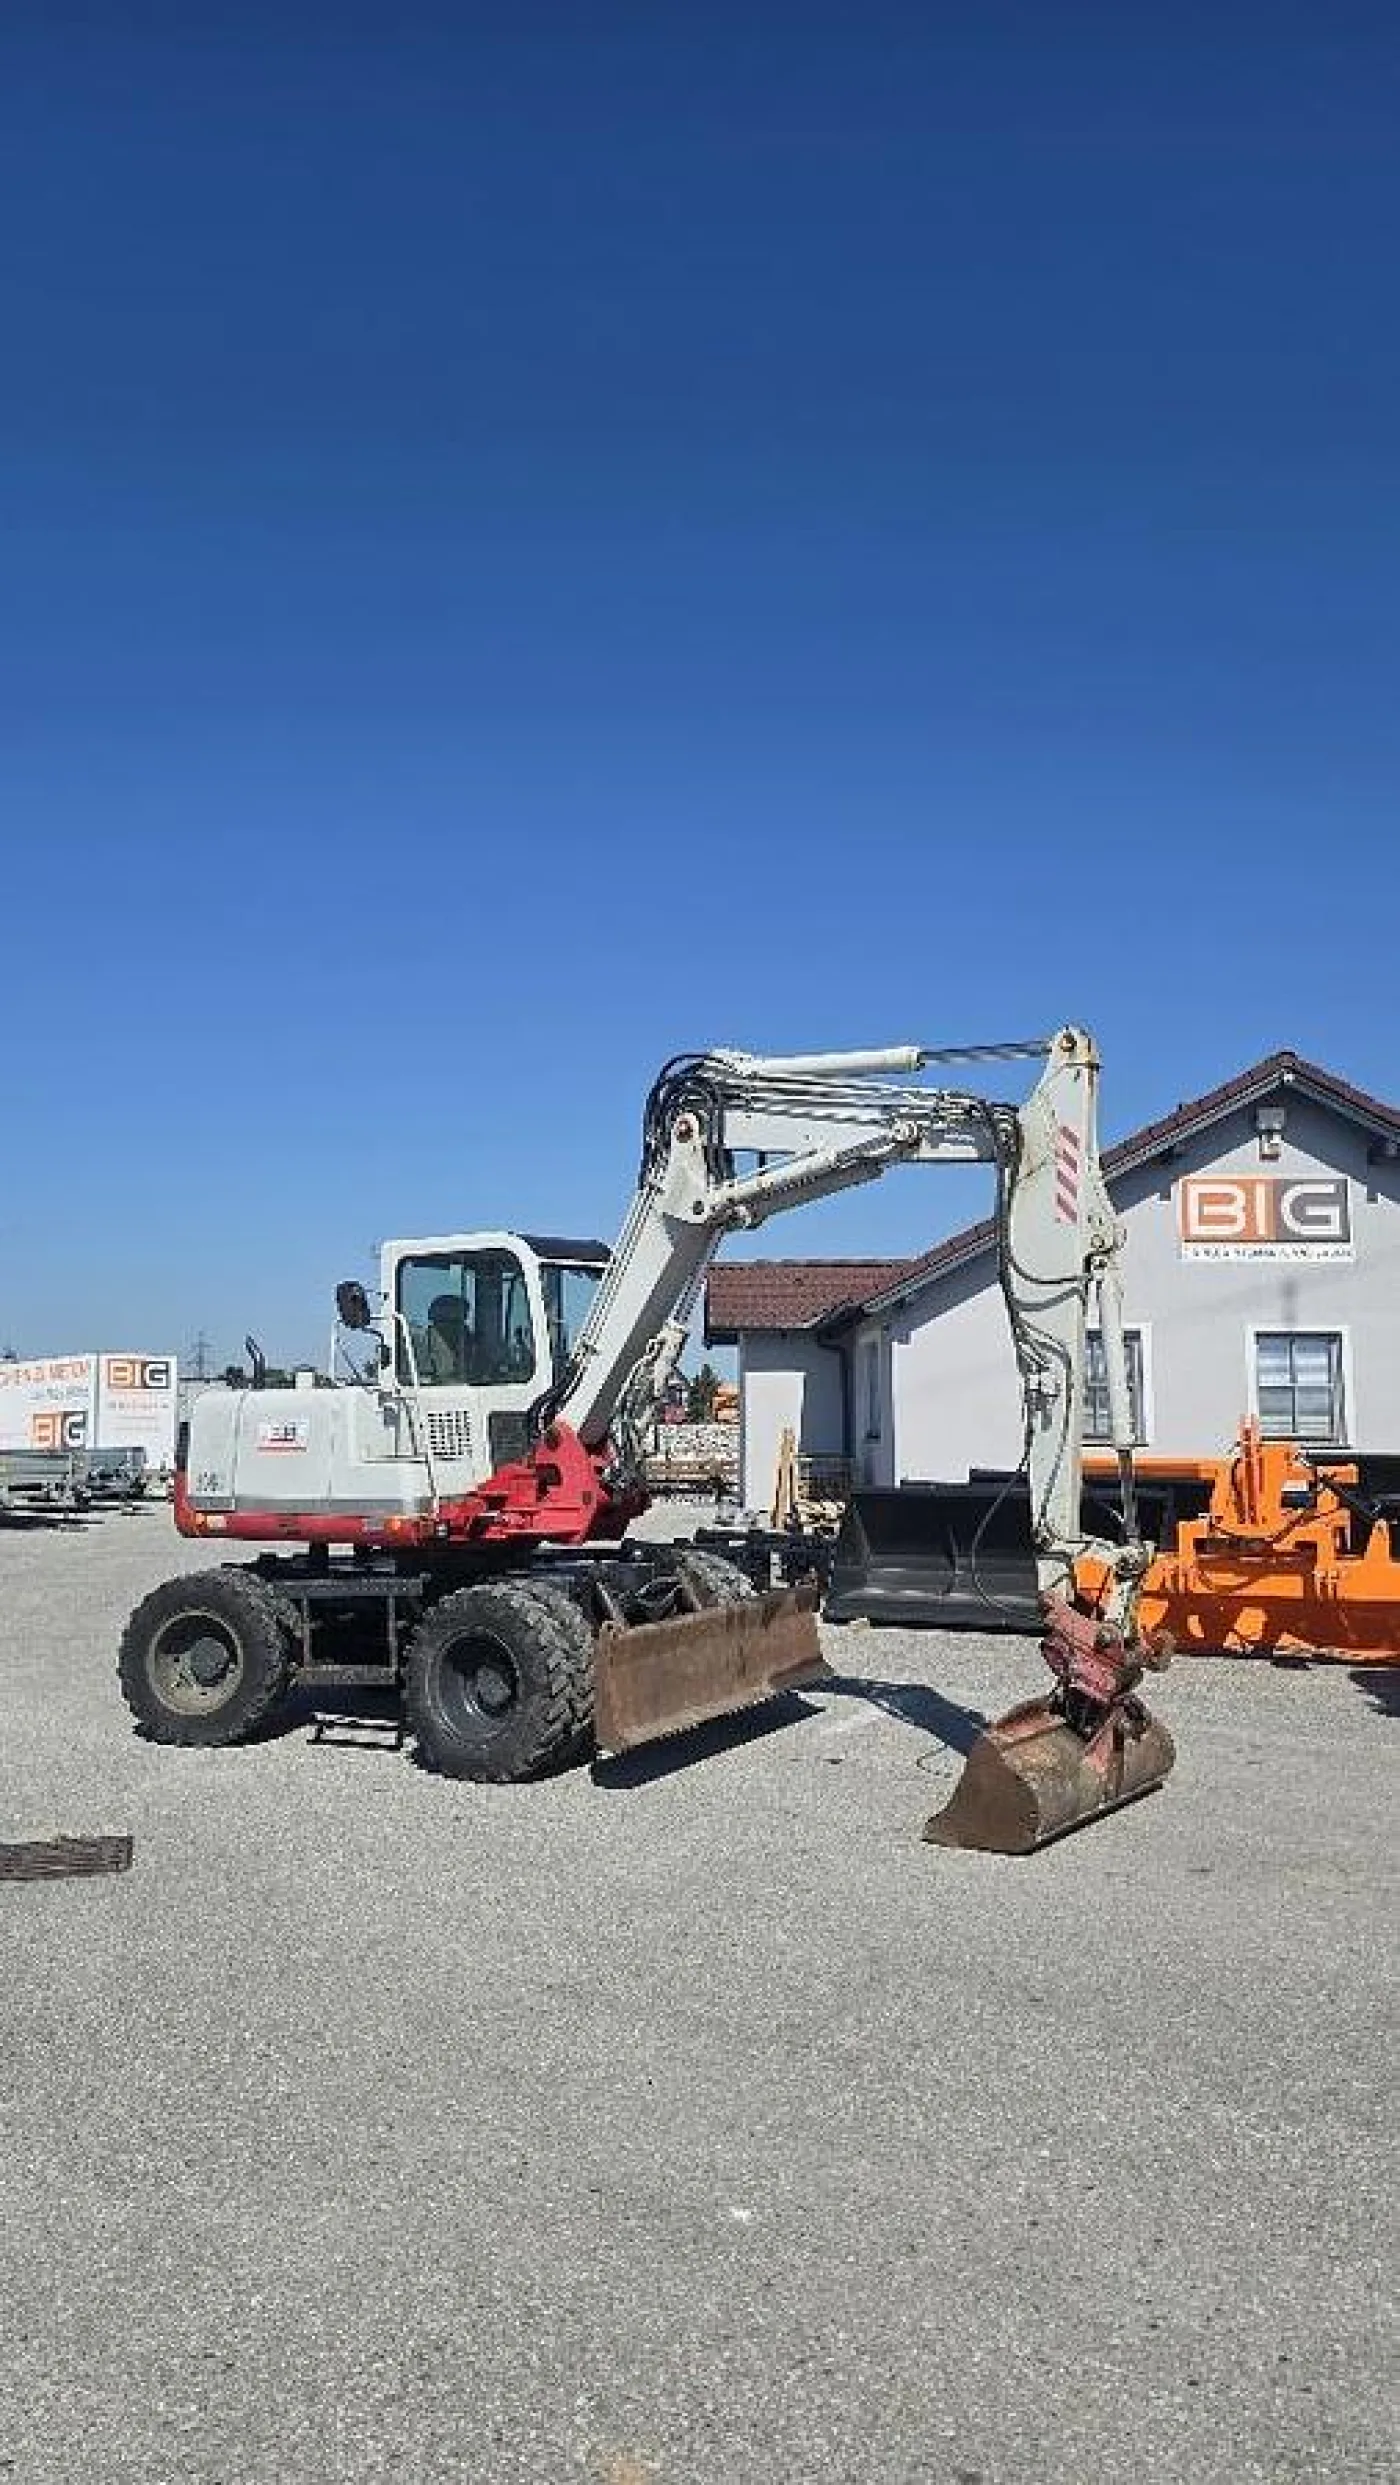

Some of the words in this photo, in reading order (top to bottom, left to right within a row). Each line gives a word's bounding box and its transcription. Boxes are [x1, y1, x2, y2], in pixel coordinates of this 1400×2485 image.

[1187, 1183, 1342, 1235] BIG
[110, 1362, 168, 1388] BIG
[34, 1413, 87, 1448] BIG
